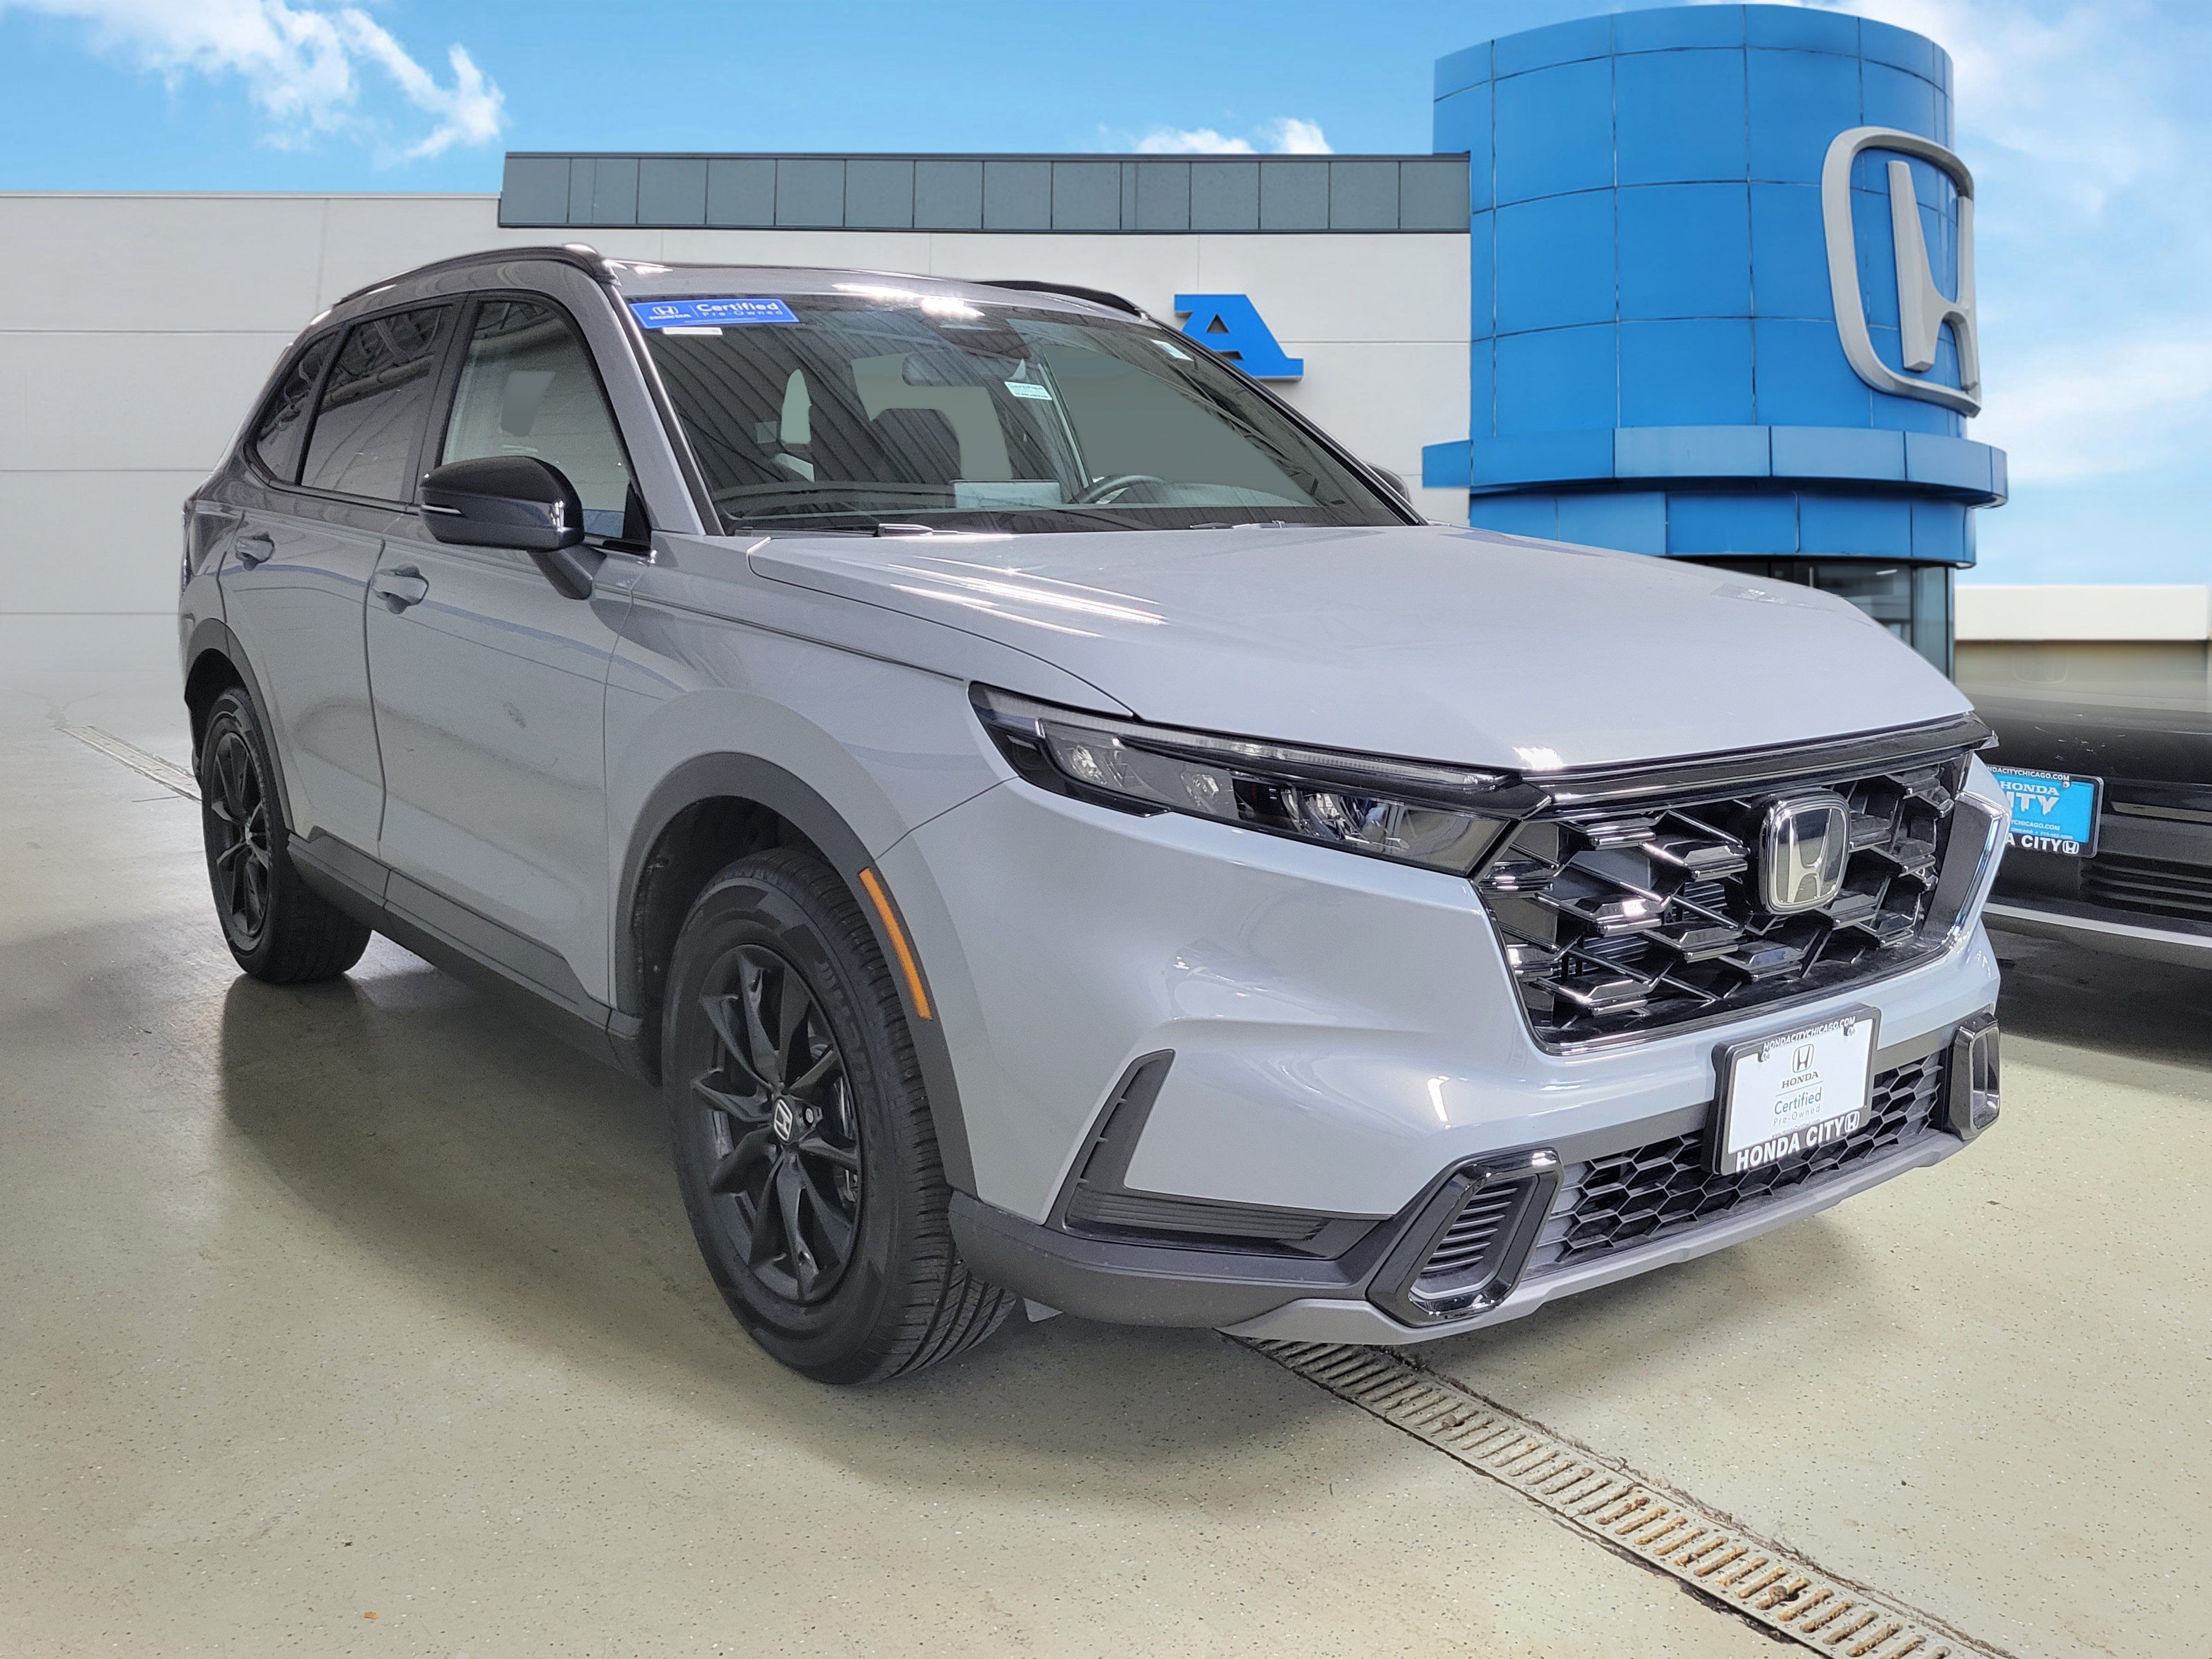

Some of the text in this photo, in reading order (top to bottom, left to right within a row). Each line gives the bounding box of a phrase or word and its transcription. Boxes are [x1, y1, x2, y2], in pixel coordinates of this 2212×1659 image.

[696, 302, 779, 312] Certified
[1173, 293, 1304, 381] A
[1987, 766, 2070, 781] NDACITYCHICAGO.COM
[2000, 781, 2060, 796] HONDA
[2006, 791, 2059, 815] ITY
[2021, 834, 2062, 852] CITY
[1763, 1016, 1855, 1051] HONDACITYCHICAGO.COM
[1781, 1071, 1819, 1088] HONDA
[1775, 1087, 1821, 1115] Certified
[1773, 1105, 1820, 1126] Pre-Owned
[1736, 1132, 1800, 1172] HONDA
[1806, 1115, 1844, 1146] CITY
